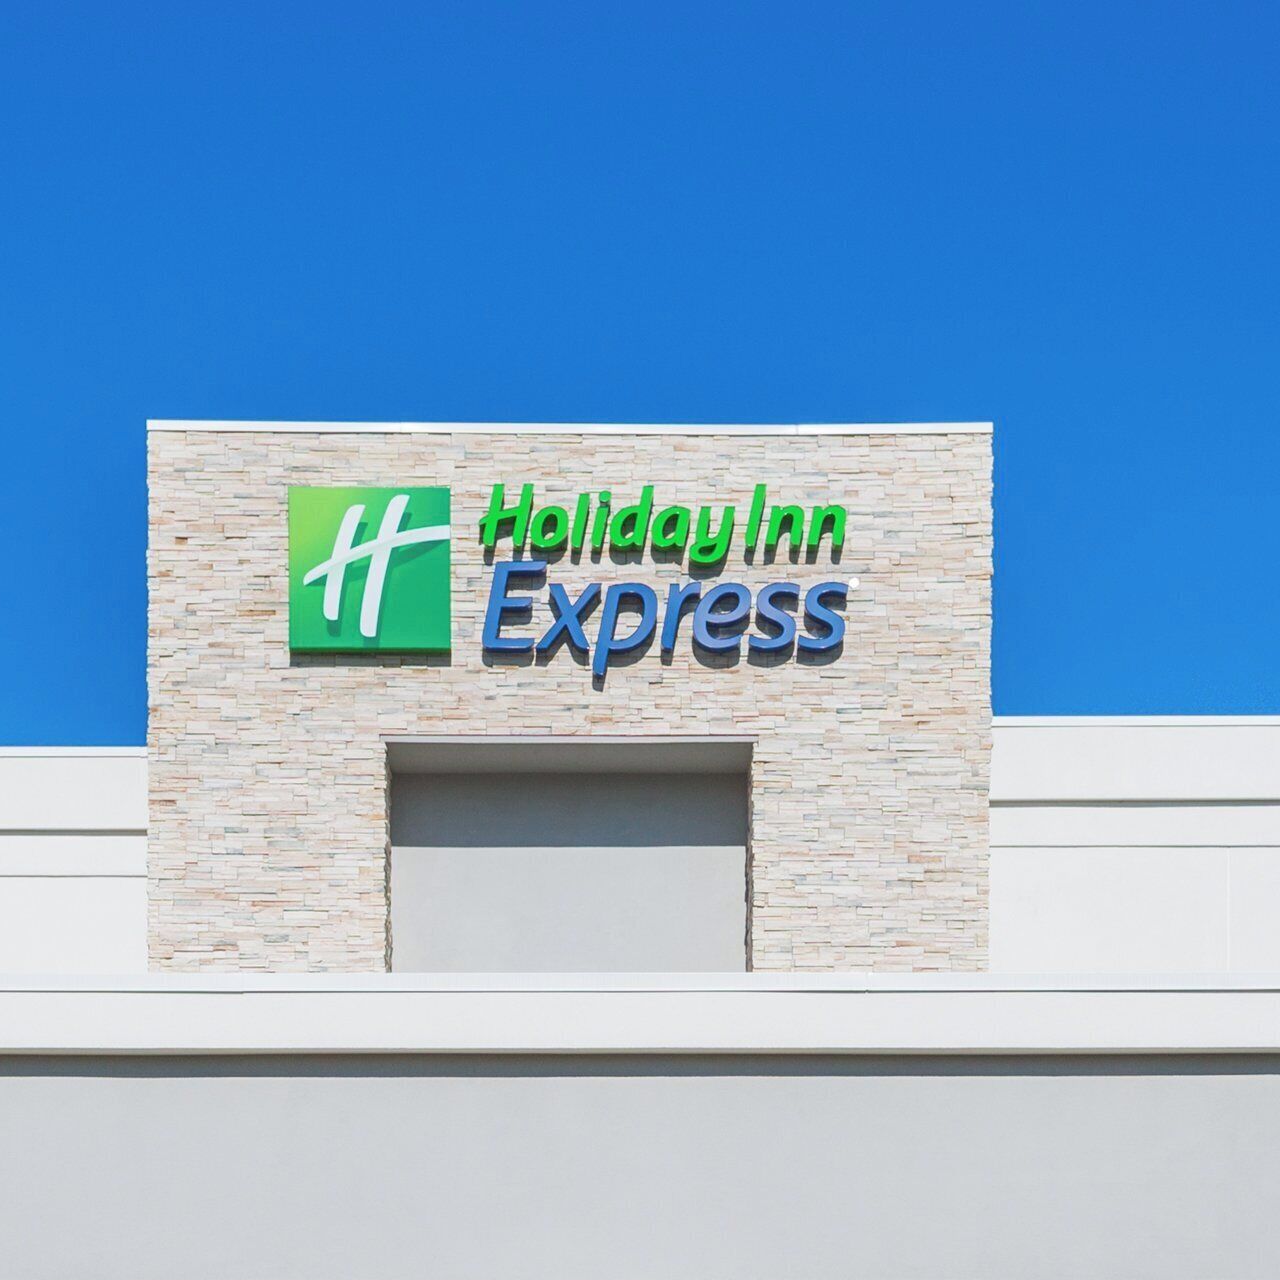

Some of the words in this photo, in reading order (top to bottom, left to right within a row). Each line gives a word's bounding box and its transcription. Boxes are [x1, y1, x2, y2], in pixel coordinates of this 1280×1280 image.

[480, 483, 735, 564] Holiday
[745, 483, 846, 553] Inn
[482, 560, 848, 676] Express
